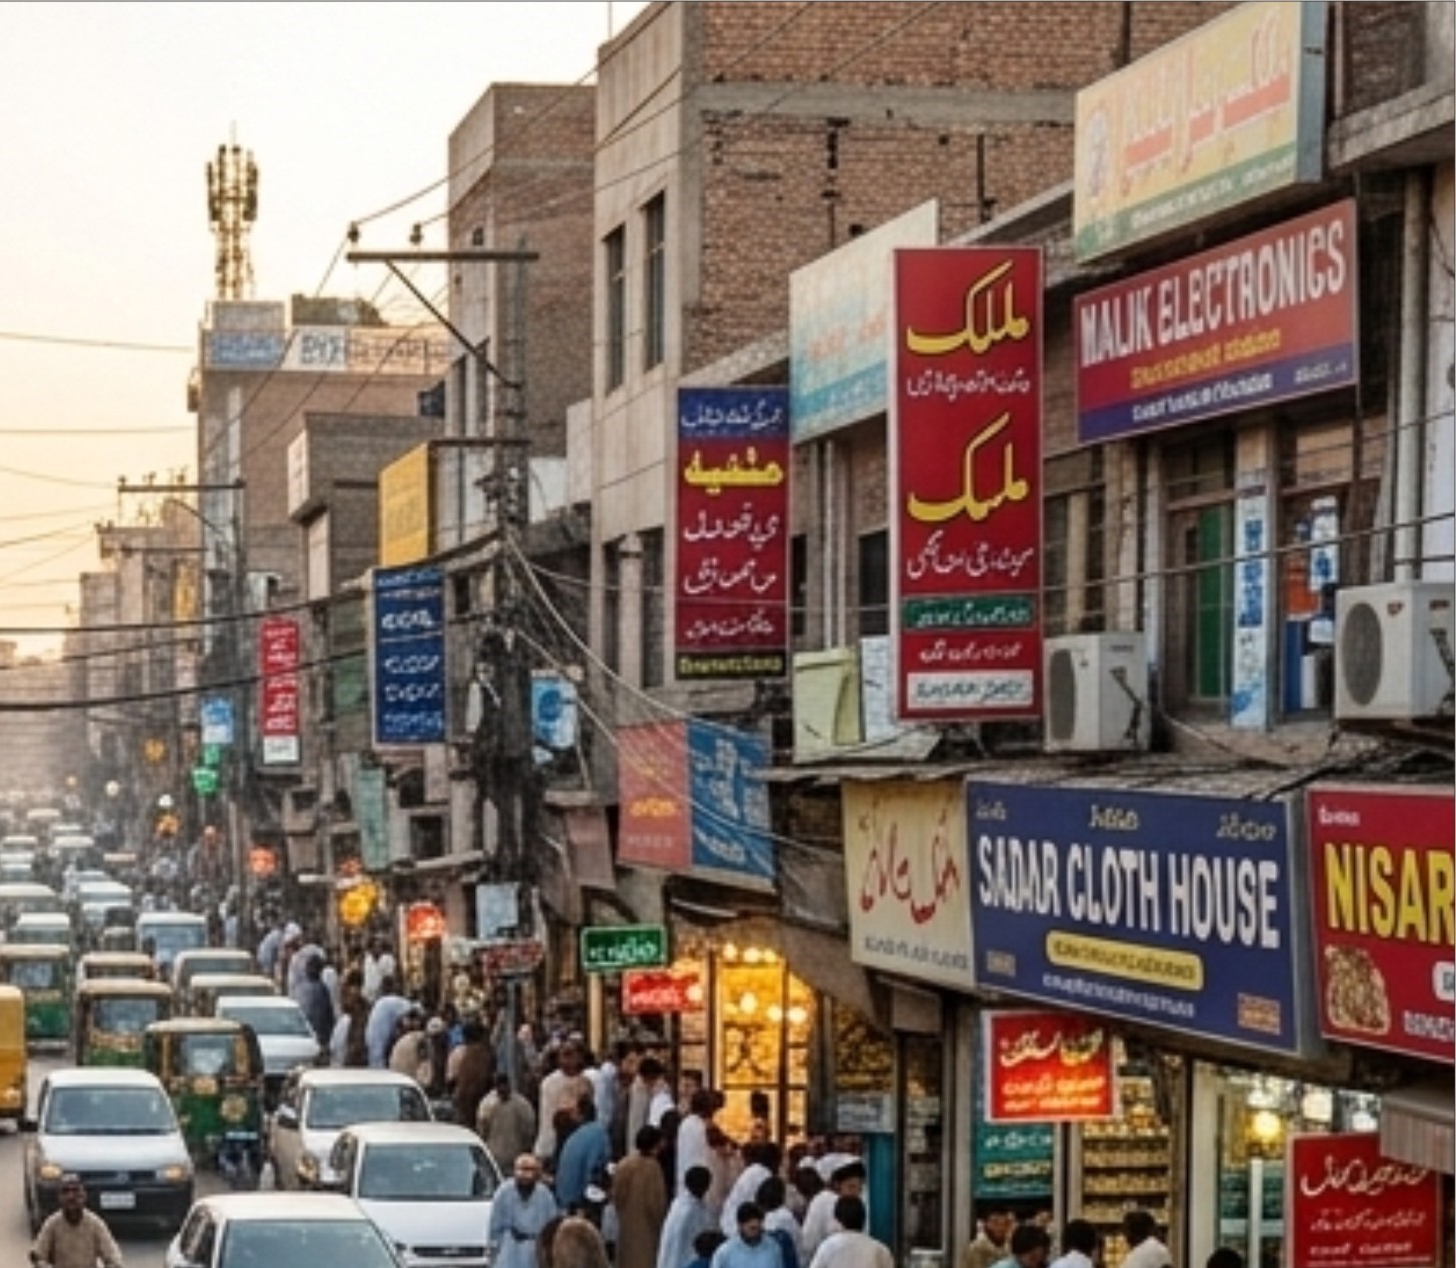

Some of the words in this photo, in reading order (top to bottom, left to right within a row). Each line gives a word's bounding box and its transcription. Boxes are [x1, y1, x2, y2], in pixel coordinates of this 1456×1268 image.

[1157, 219, 1346, 346] ELECTRONICS
[978, 834, 1061, 917] SADAR
[1066, 842, 1161, 932] CLOTH
[1167, 852, 1281, 949] HOUSE
[1323, 842, 1455, 946] NISAR
